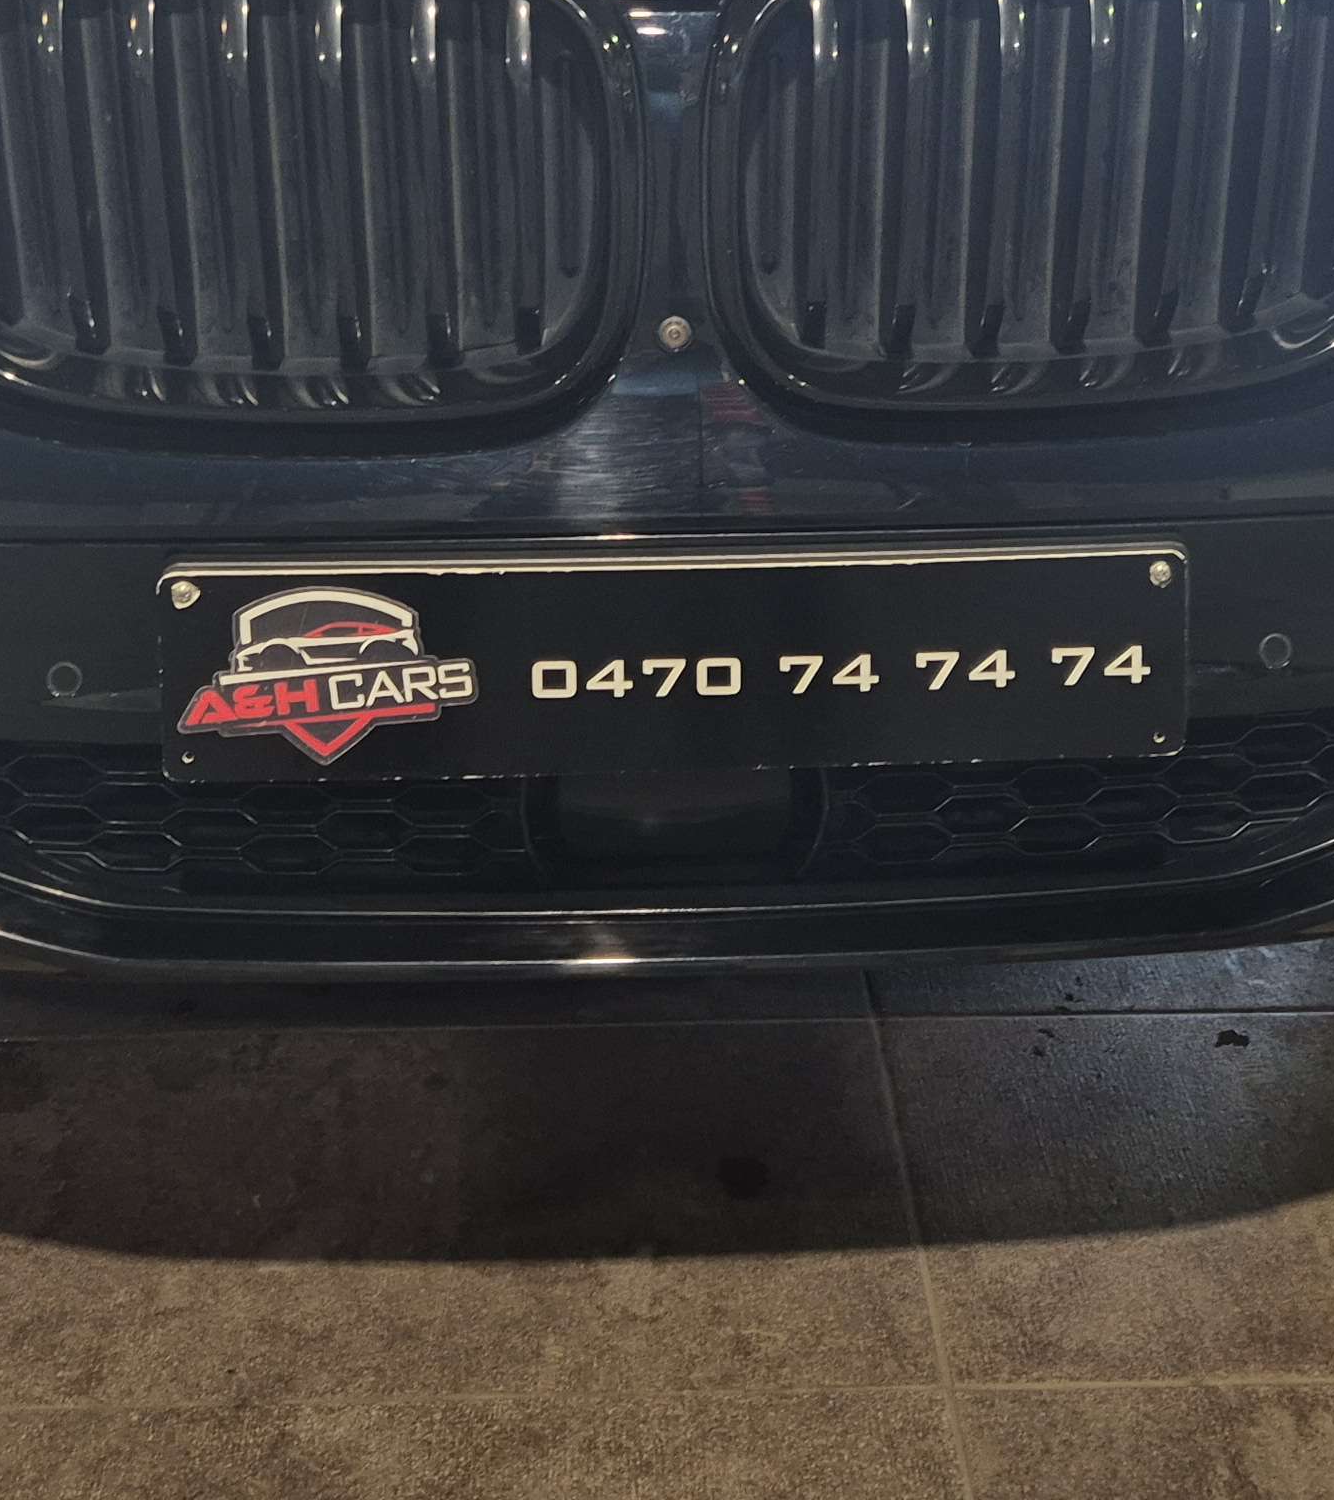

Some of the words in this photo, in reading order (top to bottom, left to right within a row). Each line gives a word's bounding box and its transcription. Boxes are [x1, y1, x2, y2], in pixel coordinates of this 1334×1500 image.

[185, 679, 320, 726] A&H
[328, 662, 473, 710] CARS
[531, 657, 742, 699] 0470
[779, 653, 880, 693] 74
[915, 649, 1016, 689] 74
[1051, 645, 1151, 684] 74
